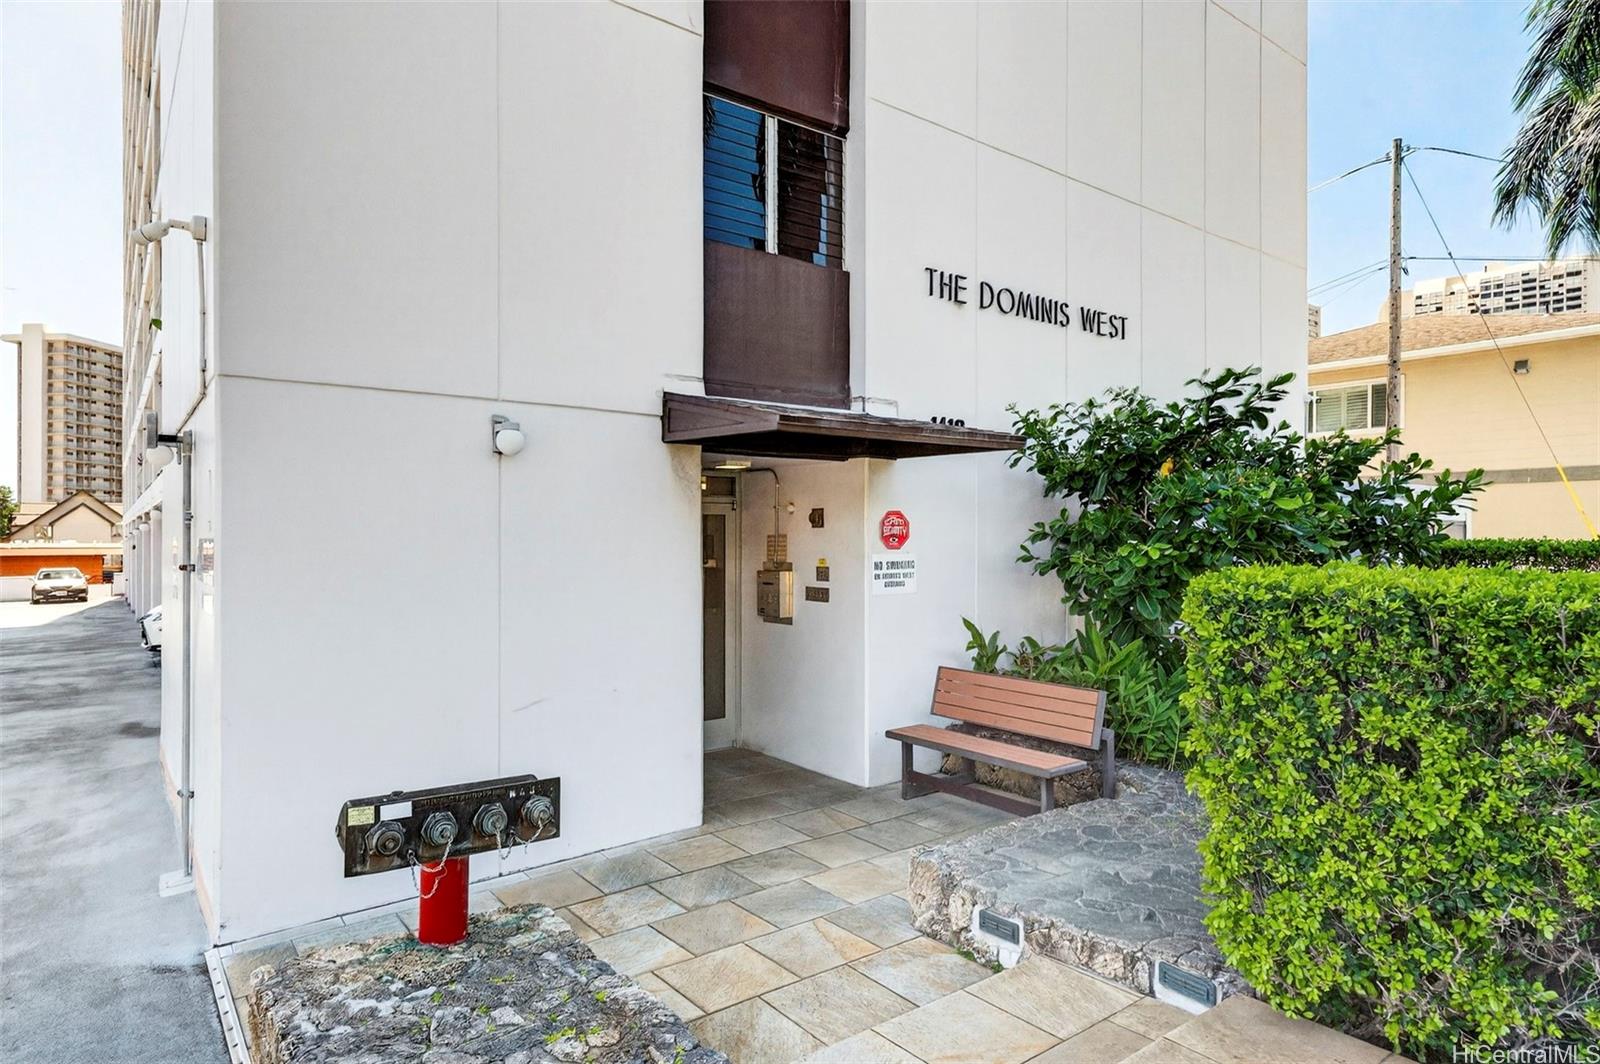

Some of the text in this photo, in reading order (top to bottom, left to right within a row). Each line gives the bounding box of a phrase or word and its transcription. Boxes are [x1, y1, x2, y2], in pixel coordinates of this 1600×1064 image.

[924, 267, 1129, 340] THE DOMINIS WEST
